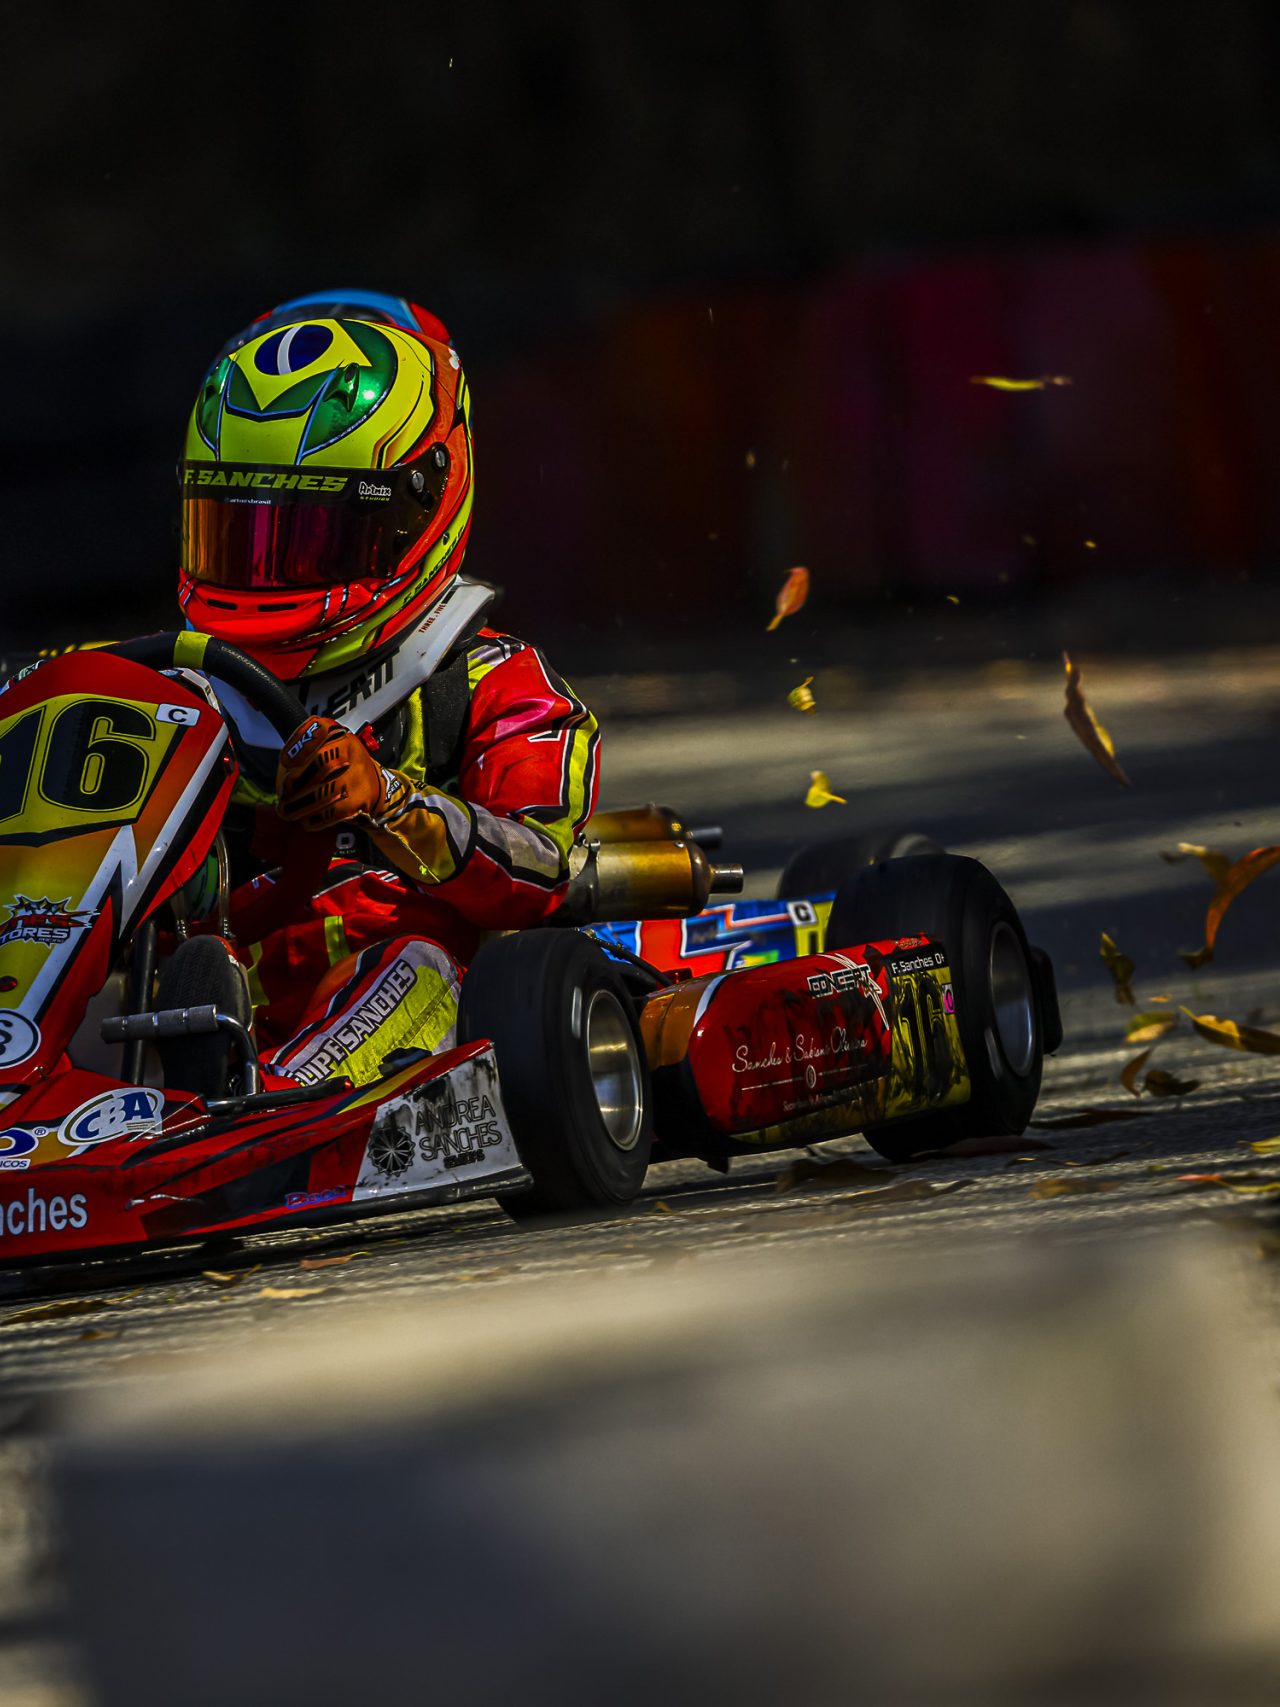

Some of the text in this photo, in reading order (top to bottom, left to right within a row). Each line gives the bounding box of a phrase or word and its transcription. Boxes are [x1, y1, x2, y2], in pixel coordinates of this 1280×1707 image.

[311, 646, 400, 722] EATT
[168, 708, 188, 723] C
[901, 954, 933, 972] Sanches
[335, 959, 417, 1053] SANCHES
[76, 1092, 155, 1138] CBA
[415, 1095, 496, 1136] ANDREA
[419, 1121, 503, 1162] SANCHES
